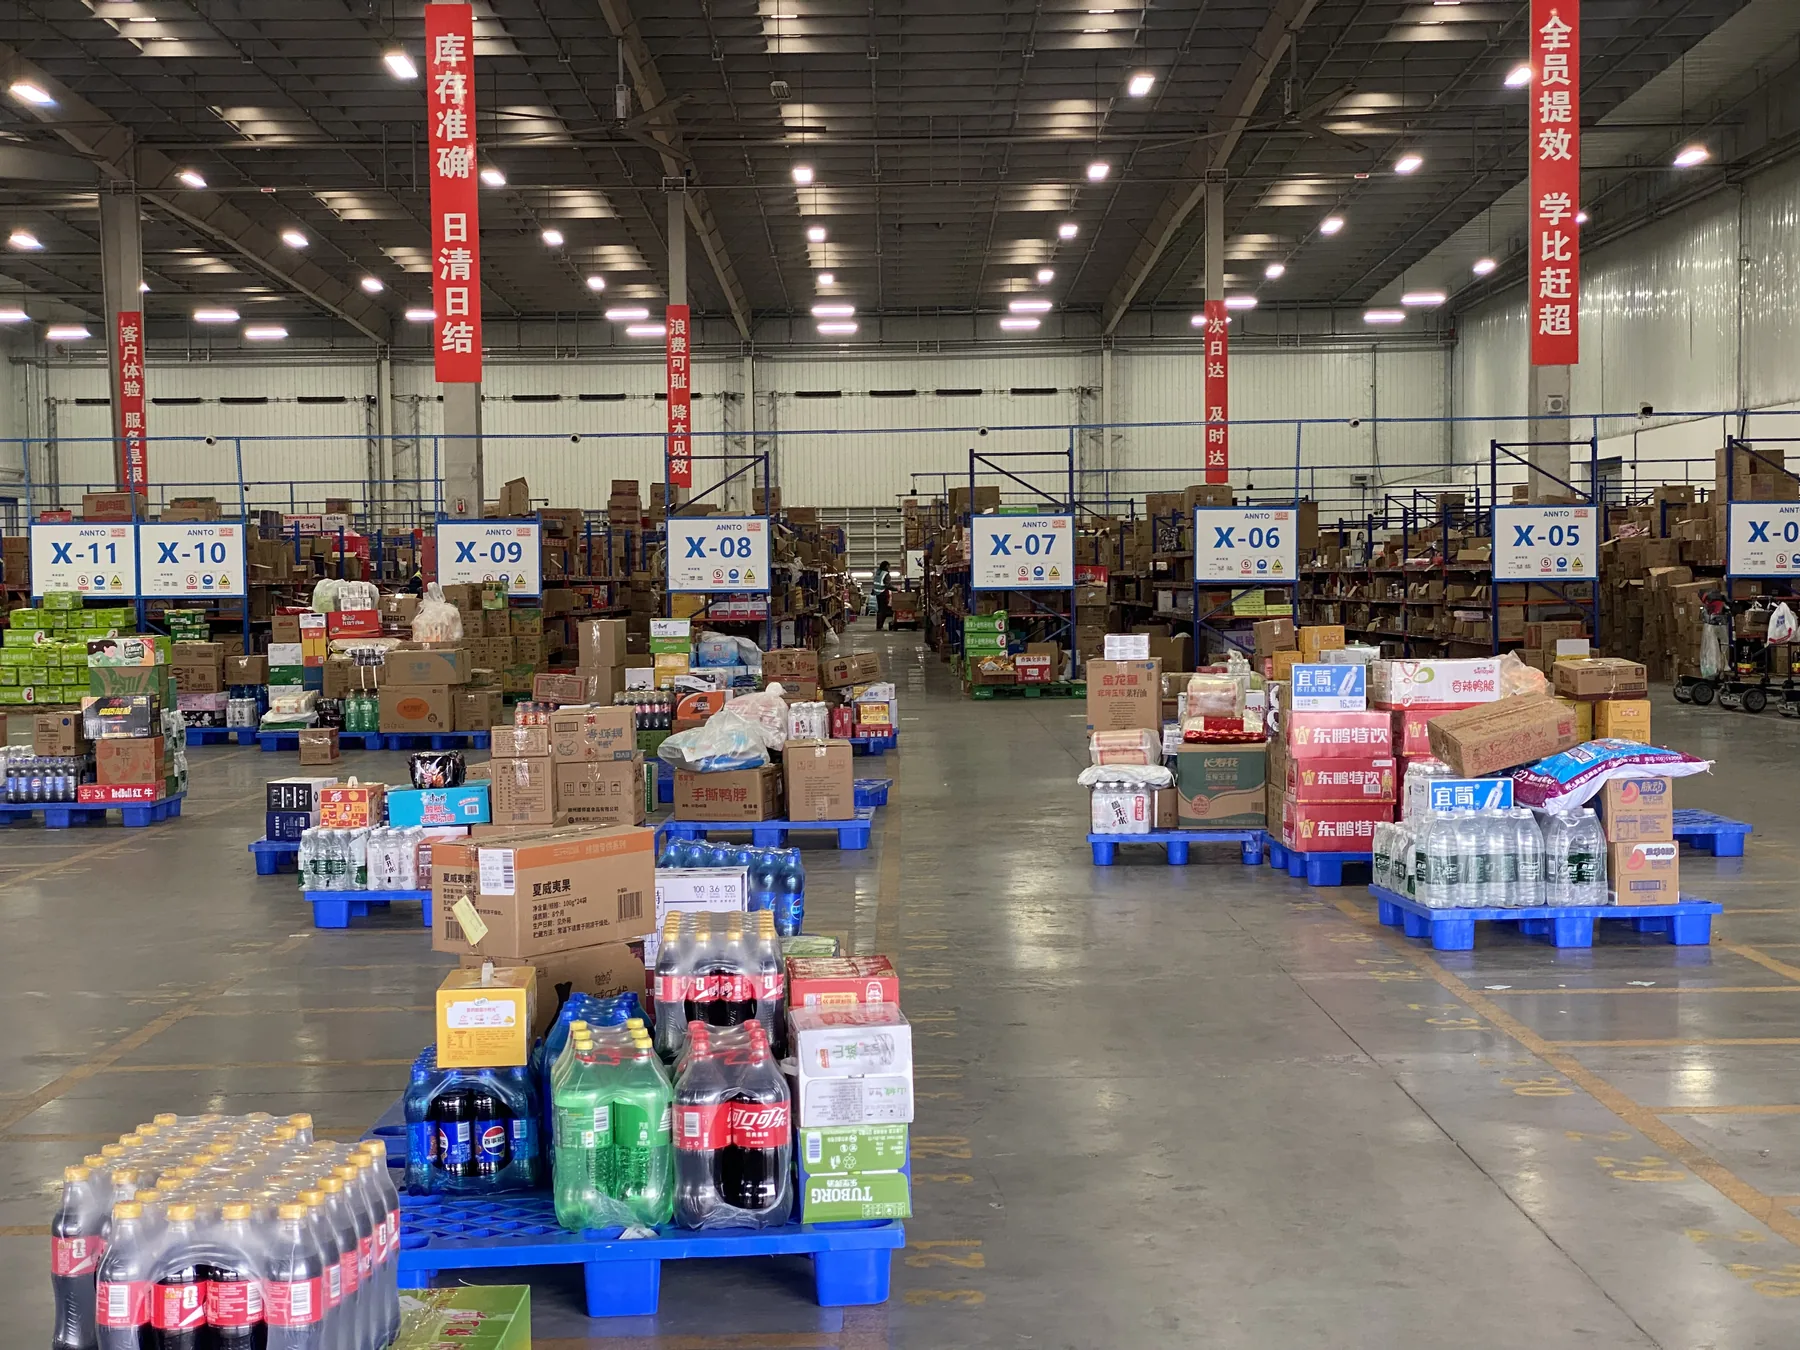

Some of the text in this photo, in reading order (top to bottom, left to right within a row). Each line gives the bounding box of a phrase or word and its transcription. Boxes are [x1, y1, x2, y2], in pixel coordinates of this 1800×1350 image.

[1538, 14, 1573, 337] 全员提效 学比赶超
[433, 32, 474, 355] 库存准确 日清日结
[121, 325, 142, 398] 客户体验
[669, 317, 689, 476] 浪费可耻 降本见效
[1207, 316, 1226, 468] 次日达 及时达
[1244, 512, 1270, 520] ANNTO
[1543, 510, 1570, 518] ANNTO
[79, 529, 106, 537] ANNTO
[187, 528, 214, 537] ANNTO
[485, 528, 512, 536] ANNTO
[1022, 520, 1048, 528] ANNTO
[1748, 521, 1800, 543] X-0
[990, 533, 1057, 556] X-07
[1213, 526, 1281, 549] X-06
[1512, 524, 1580, 547] X-05
[51, 542, 117, 564] X-11
[157, 541, 226, 564] X-10
[455, 541, 523, 563] X-09
[685, 536, 752, 558] X-08
[1296, 669, 1332, 687] 宜简
[1452, 679, 1495, 694] 香辣鸭腿
[1312, 727, 1389, 744] 东鹏特饮
[1317, 770, 1381, 785] 东鹏特饮
[132, 787, 154, 798] 红牛
[691, 788, 748, 803] 手撕鸭脖
[1433, 786, 1475, 807] 宜简
[1640, 781, 1664, 794] 脉动
[532, 878, 571, 897] 夏威夷果
[724, 885, 736, 893] 120
[811, 1186, 874, 1204] TUBORG
